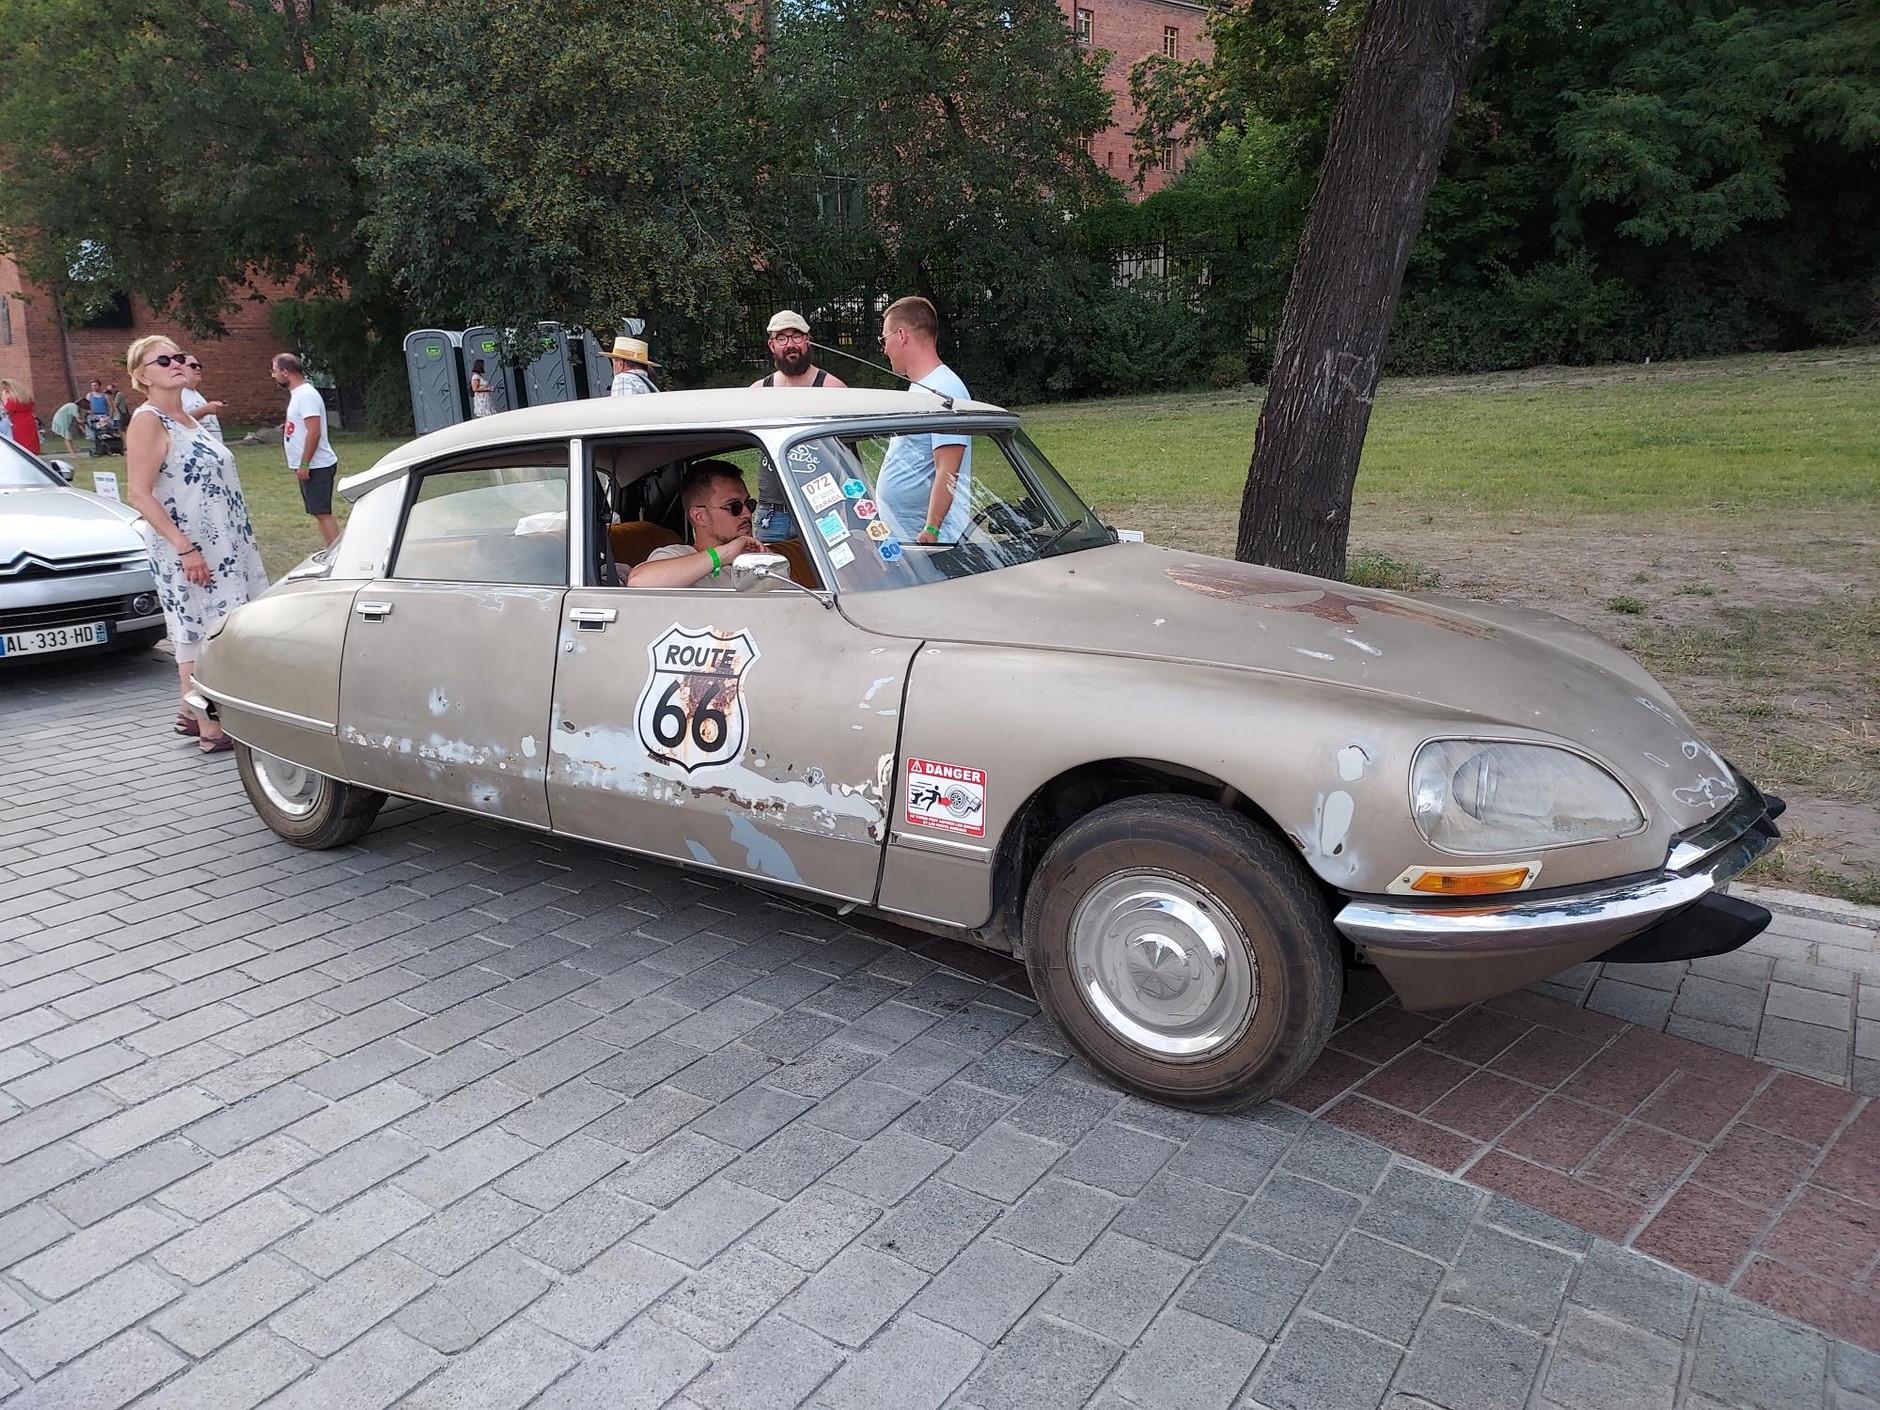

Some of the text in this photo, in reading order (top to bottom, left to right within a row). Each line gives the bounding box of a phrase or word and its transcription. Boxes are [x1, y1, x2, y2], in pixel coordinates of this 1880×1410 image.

[806, 476, 832, 495] 072
[844, 481, 864, 496] 83
[815, 494, 841, 511] PARADA
[856, 501, 877, 517] 82
[870, 523, 888, 537] 81
[881, 543, 900, 559] 80
[665, 644, 737, 668] ROUTE
[653, 679, 727, 752] 66
[925, 763, 981, 783] DANGER
